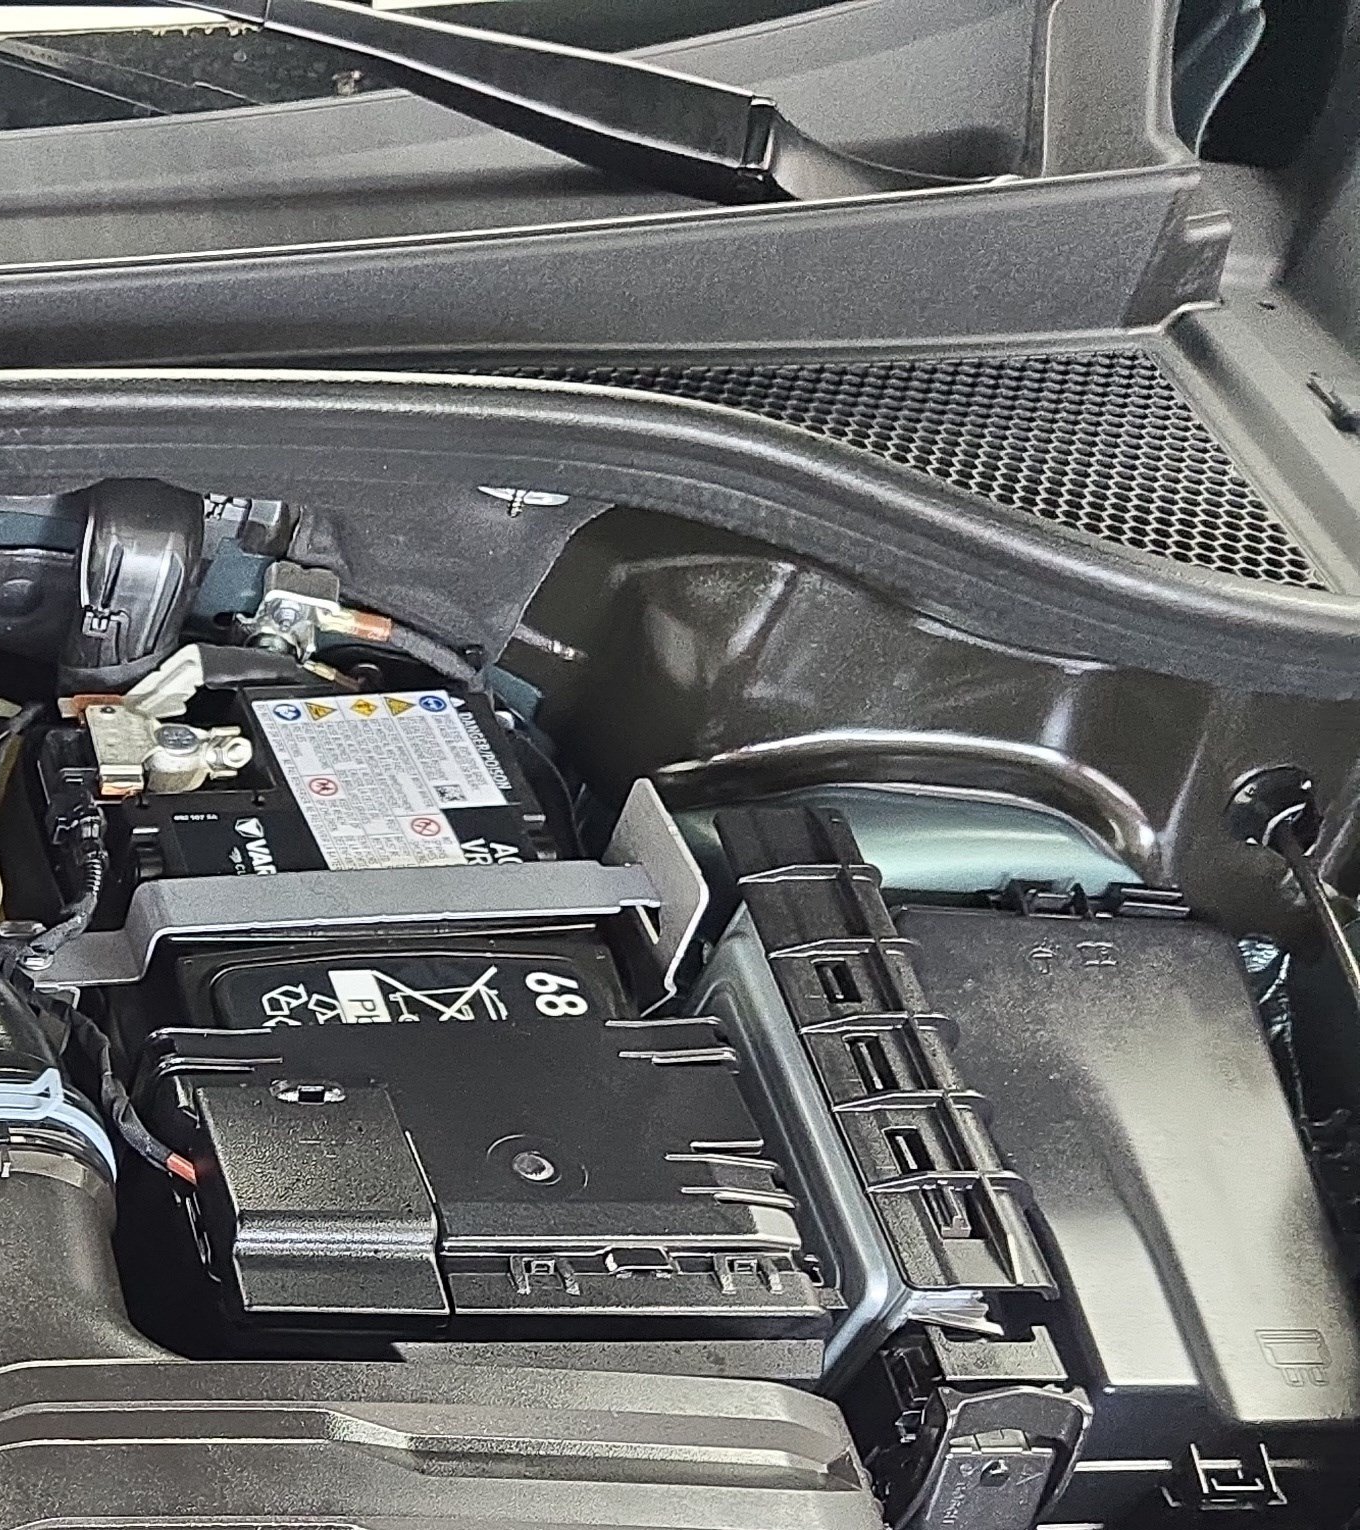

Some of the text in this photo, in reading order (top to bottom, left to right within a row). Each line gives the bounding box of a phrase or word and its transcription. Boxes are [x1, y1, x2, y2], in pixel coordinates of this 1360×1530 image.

[463, 713, 512, 791] DANGER/POISON
[245, 838, 277, 876] VAR
[524, 970, 588, 1018] 68
